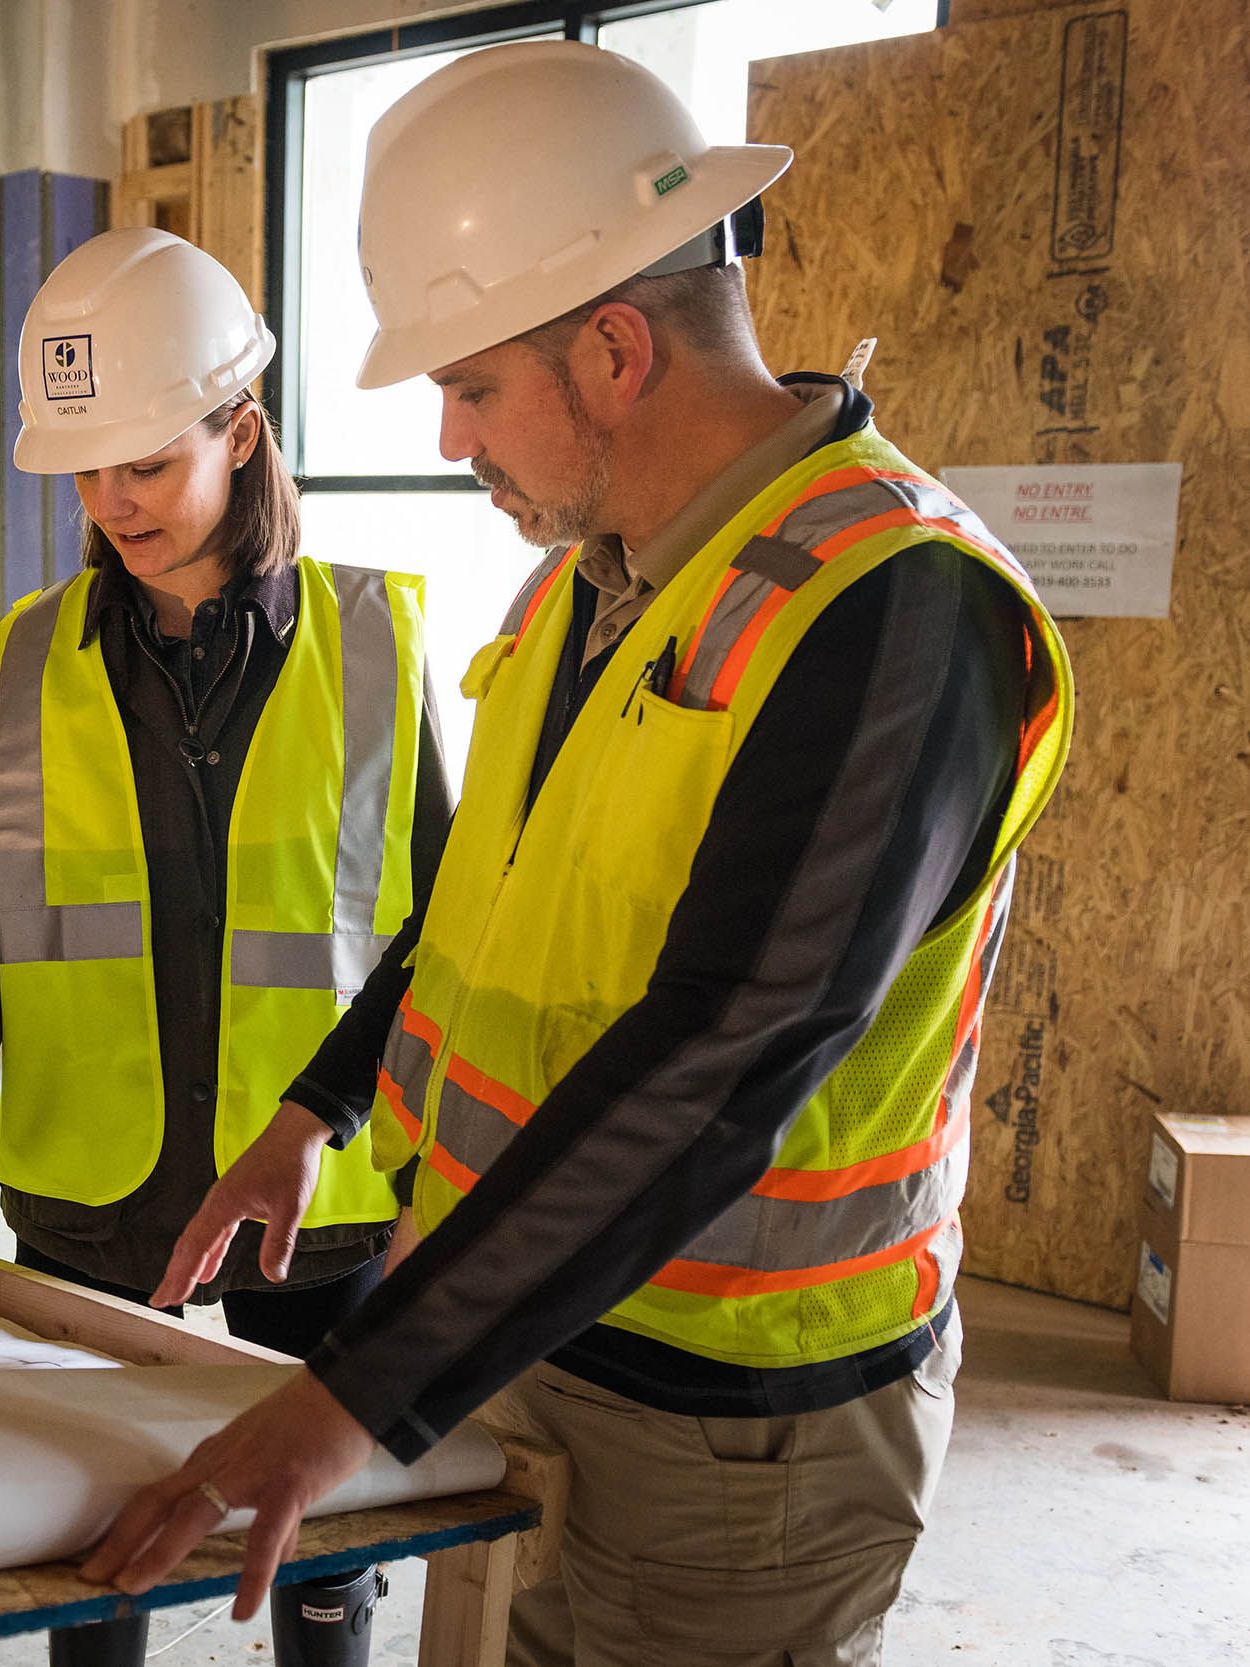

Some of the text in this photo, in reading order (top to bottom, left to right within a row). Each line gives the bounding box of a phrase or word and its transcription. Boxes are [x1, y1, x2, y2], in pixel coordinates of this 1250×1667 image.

[657, 169, 685, 193] MSA
[48, 370, 88, 383] WOOD
[57, 406, 87, 415] CAITLIN
[1016, 483, 1041, 497] NO
[1014, 504, 1038, 520] NO
[1040, 543, 1055, 554] TO
[1059, 543, 1096, 554] ENTER
[1101, 543, 1116, 554] TO
[1051, 560, 1085, 570] WORK
[1090, 560, 1116, 570] CALL
[303, 1609, 342, 1618] HUNTER
